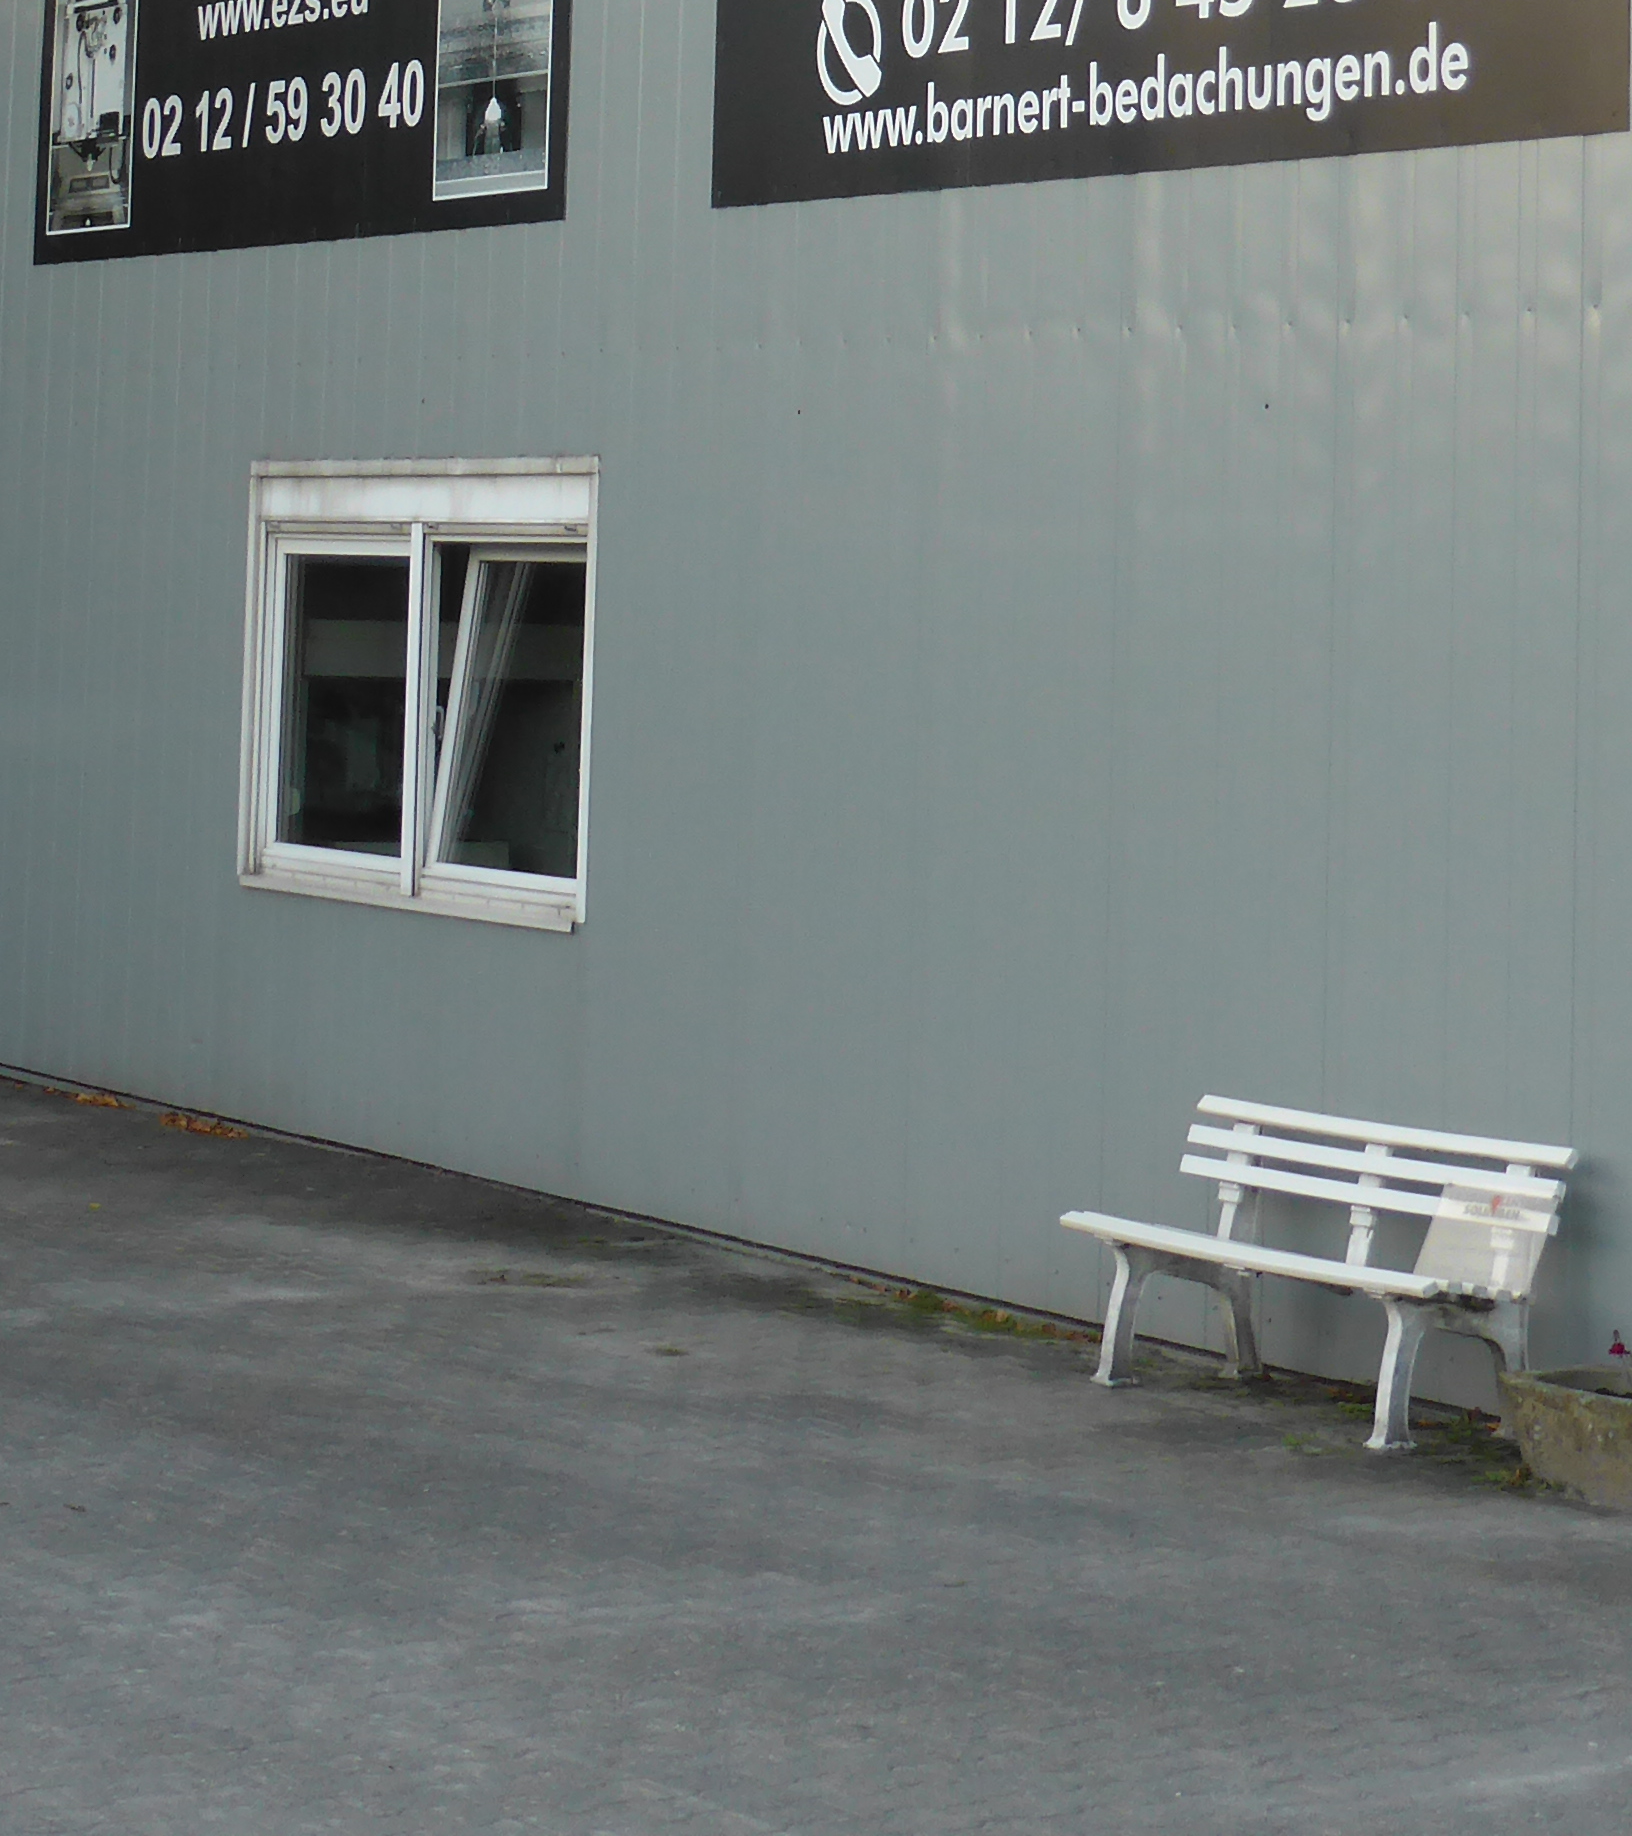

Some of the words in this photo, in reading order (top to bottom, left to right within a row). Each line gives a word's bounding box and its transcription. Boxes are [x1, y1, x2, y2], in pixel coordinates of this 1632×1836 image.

[142, 94, 182, 159] 02
[196, 87, 234, 152] 12
[265, 76, 308, 144] 59
[321, 69, 366, 137] 30
[378, 60, 424, 128] 40
[823, 22, 1470, 154] www.barnert-bedachungen.de
